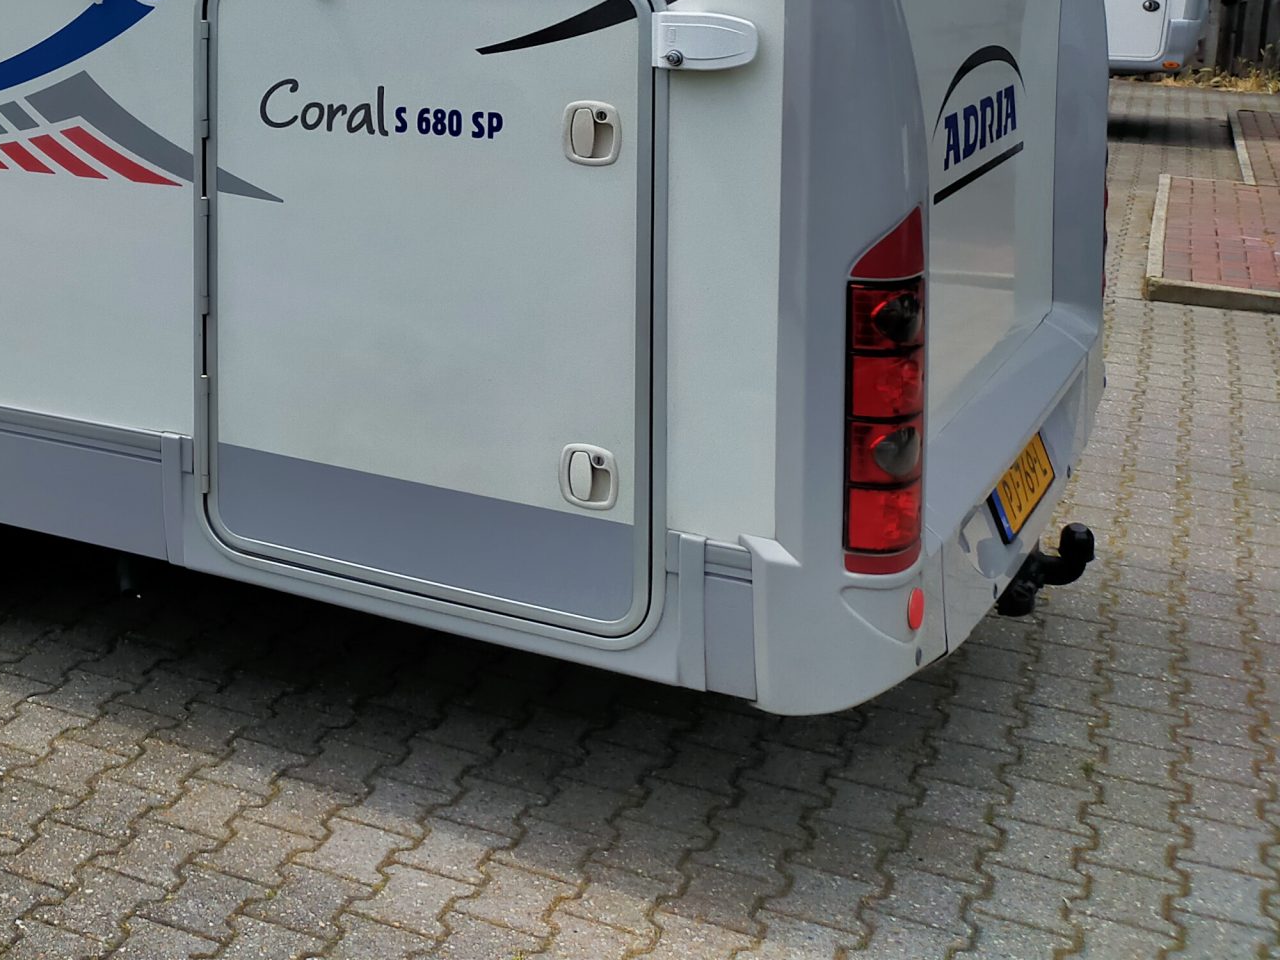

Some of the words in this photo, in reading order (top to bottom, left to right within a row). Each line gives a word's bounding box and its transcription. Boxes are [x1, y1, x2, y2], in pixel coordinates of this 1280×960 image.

[259, 78, 389, 137] Coral
[394, 106, 408, 134] S
[416, 107, 463, 137] 680
[471, 111, 504, 140] SP
[943, 84, 1017, 172] ADRIA
